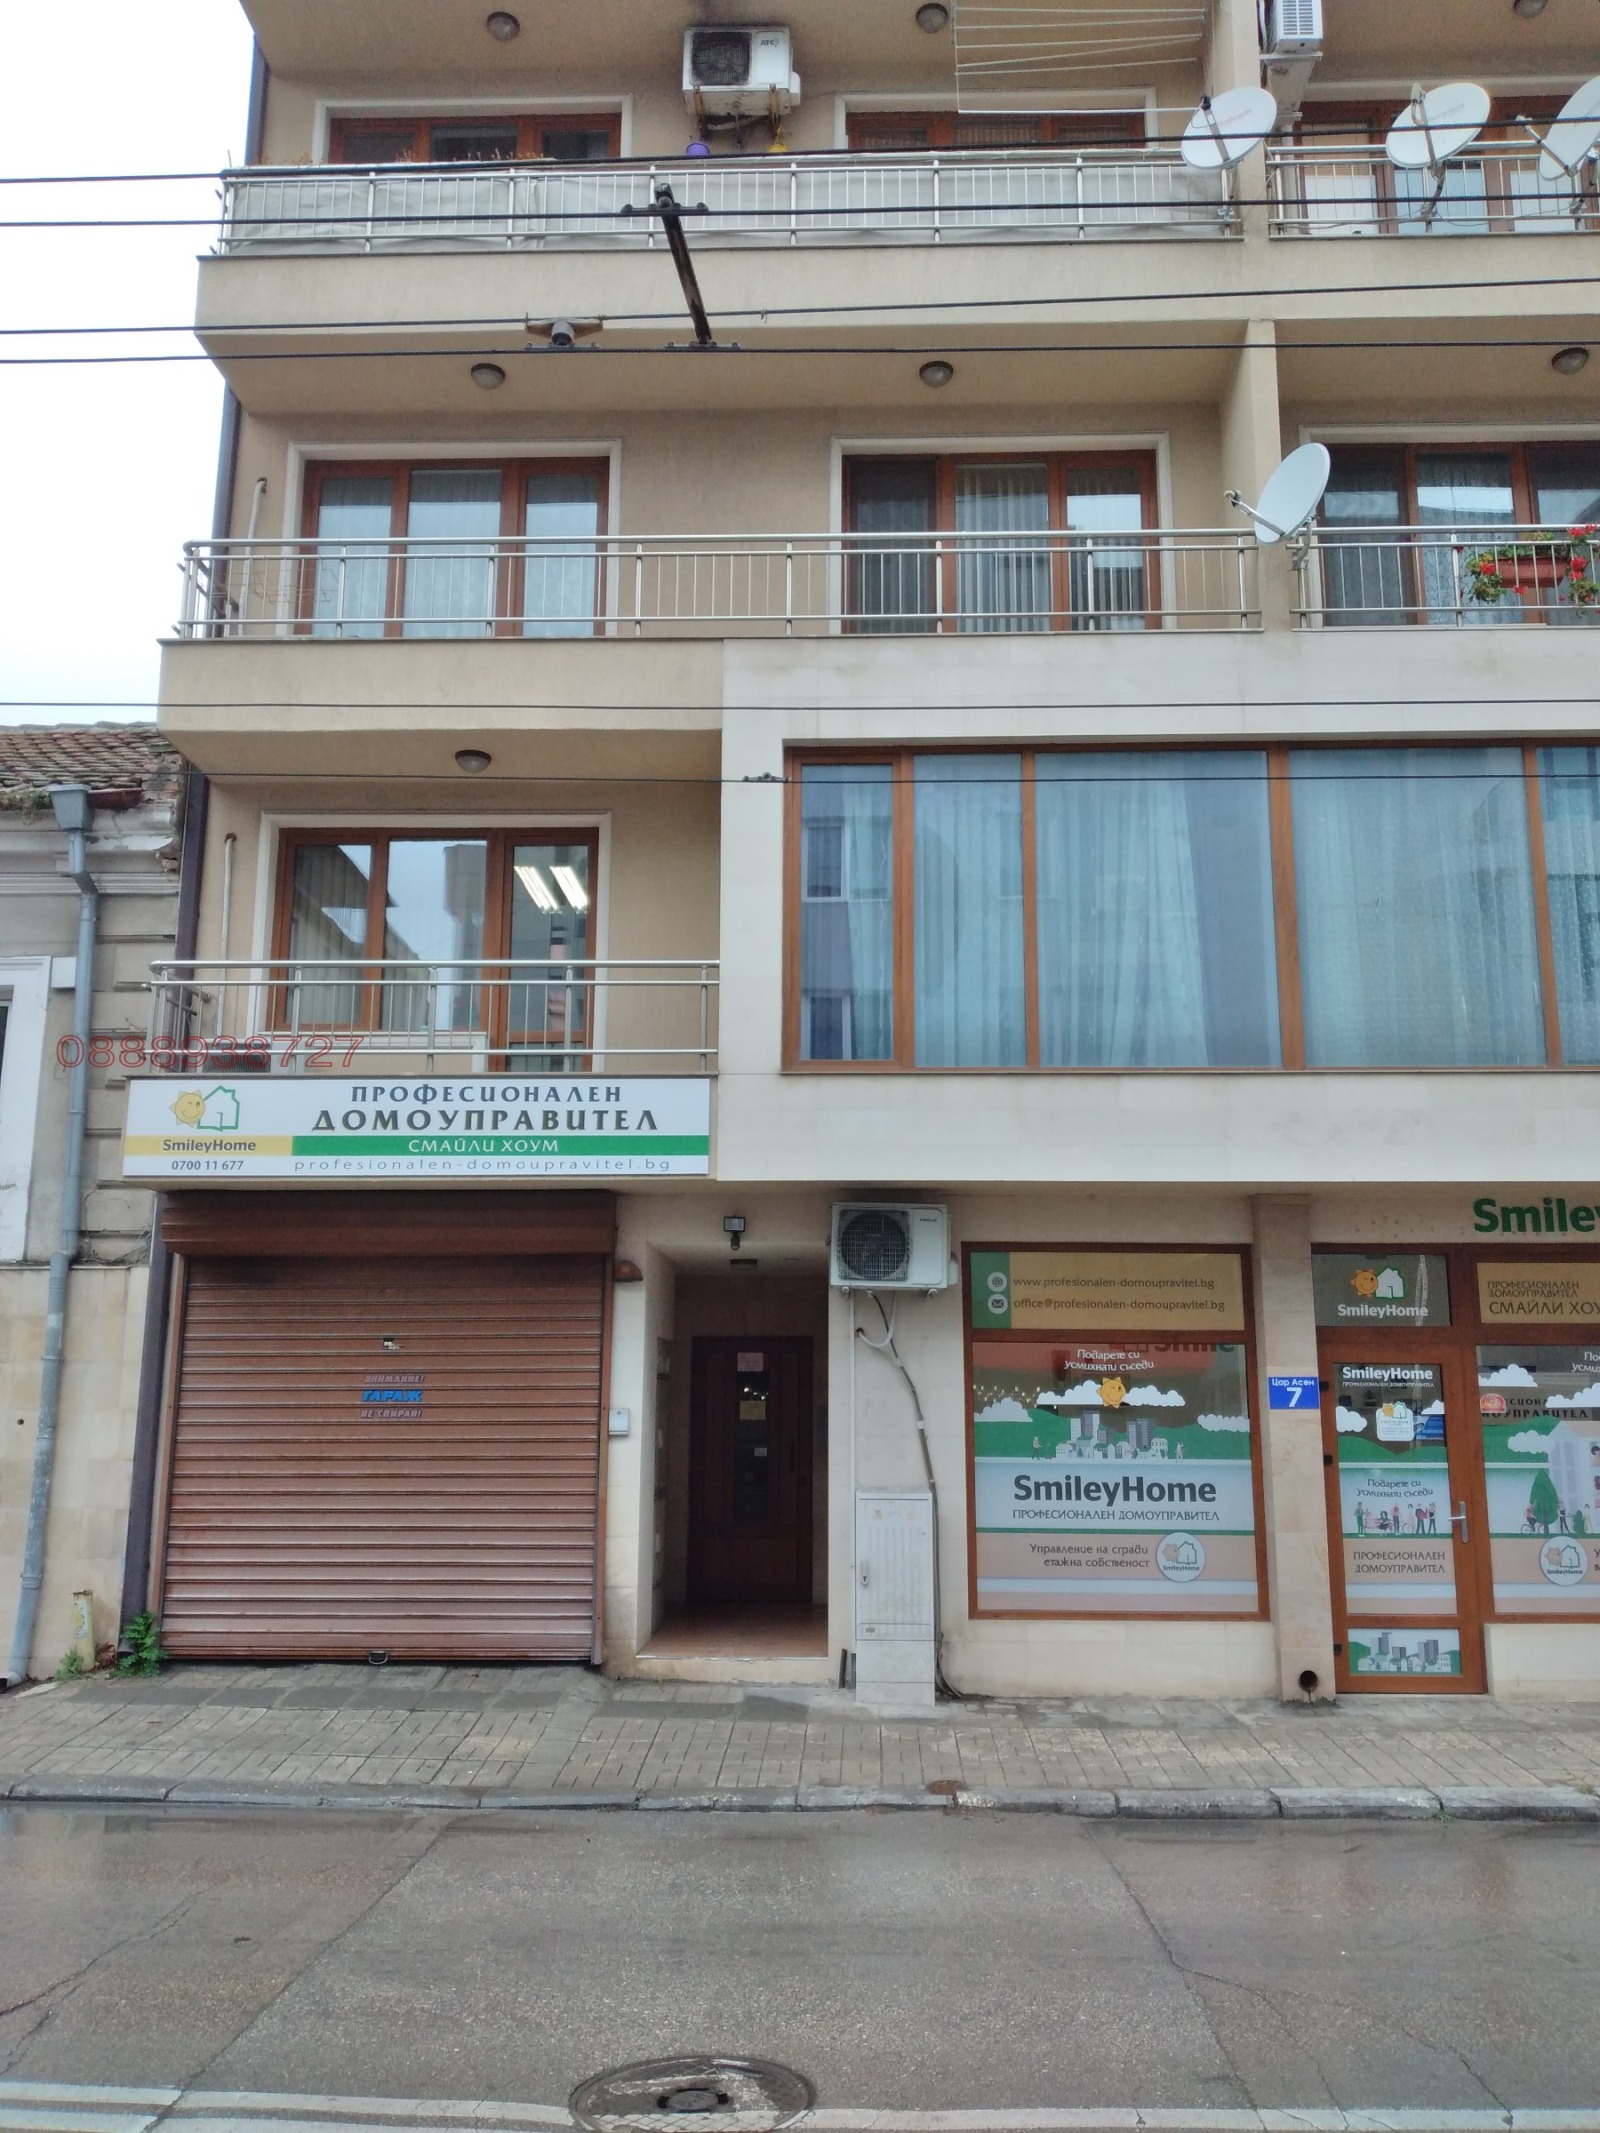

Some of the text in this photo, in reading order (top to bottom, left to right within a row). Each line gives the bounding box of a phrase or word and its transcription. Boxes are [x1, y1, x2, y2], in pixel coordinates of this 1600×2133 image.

[351, 1084, 621, 1104] ПРОФЕСИОНАЛЕН
[312, 1109, 658, 1131] ДОМОУПРАВИТЕЛ
[163, 1139, 257, 1153] SmileyHome
[408, 1138, 559, 1152] СМАЙЛИ ХОУМ
[171, 1160, 244, 1171] 0700 11 677
[294, 1159, 670, 1172] profesionalen-domoupravitel.bg
[1013, 1276, 1215, 1290] www.profesionalen-domoupravitel.bg
[1487, 1281, 1579, 1290] ПРОФЕСИОНАЛЕН
[1488, 1289, 1579, 1298] ДОМОУПРАВИТЕЛ
[1013, 1298, 1225, 1312] office@profesionalen-domoupravitel.bg
[1337, 1304, 1429, 1318] SmileyHome
[1489, 1300, 1563, 1315] СМАЙЛИ
[1077, 1348, 1140, 1361] Подарете си
[1063, 1360, 1155, 1371] усмихнати съседи
[1342, 1366, 1433, 1381] SmileyHome
[1271, 1378, 1289, 1387] Цар
[361, 1389, 422, 1402] ГАРАЖ
[1286, 1387, 1302, 1408] 7
[360, 1409, 374, 1418] НЕ
[1367, 1478, 1408, 1489] Подарете
[1013, 1474, 1217, 1507] SmileyHome
[1356, 1487, 1433, 1498] усмихнати съседи
[1012, 1509, 1219, 1521] ПРОФЕСИОНАЛЕН ДОМОУПРАВИТЕЛ
[1030, 1544, 1093, 1555] Управление
[1111, 1545, 1148, 1556] сгради
[1353, 1551, 1445, 1560] ПРОФЕСИОНАЛЕН
[1044, 1557, 1150, 1568] етажна собственост
[1355, 1564, 1445, 1573] ДОМОУПРАВИТЕЛ
